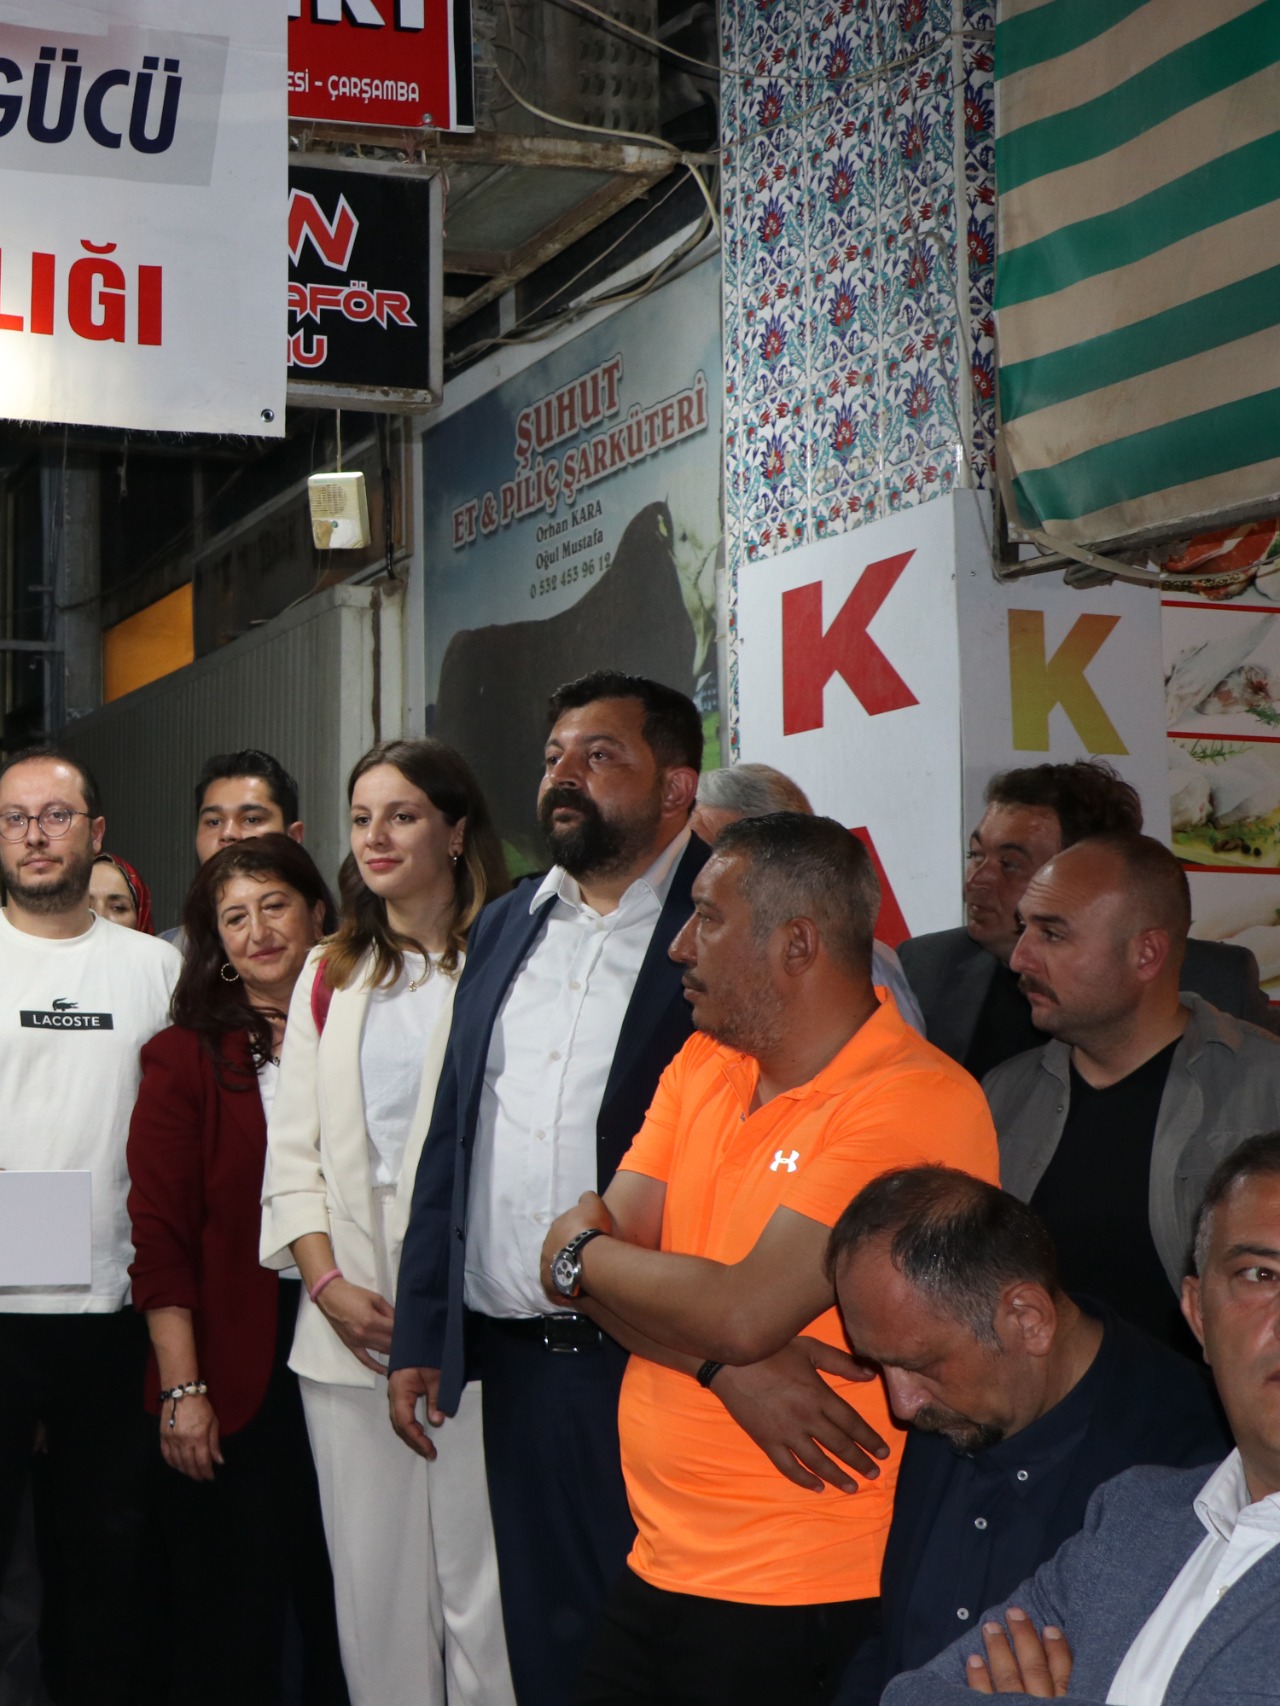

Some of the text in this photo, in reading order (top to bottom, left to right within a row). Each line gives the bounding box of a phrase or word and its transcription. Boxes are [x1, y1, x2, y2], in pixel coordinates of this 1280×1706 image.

[328, 75, 419, 104] ÇARŞAMBA
[516, 358, 620, 469] ŞUHUT
[452, 377, 706, 544] ET & PİLİÇ ŞARKÜTERİ
[536, 499, 603, 543] Orhan KARA
[536, 528, 604, 571] Oğul Mustafa
[530, 584, 537, 599] 0
[539, 575, 557, 596] 532
[560, 565, 579, 587] 453
[581, 558, 595, 579] 96
[782, 548, 920, 737] K
[1008, 609, 1130, 756] K
[33, 1014, 100, 1026] LACOSTE
